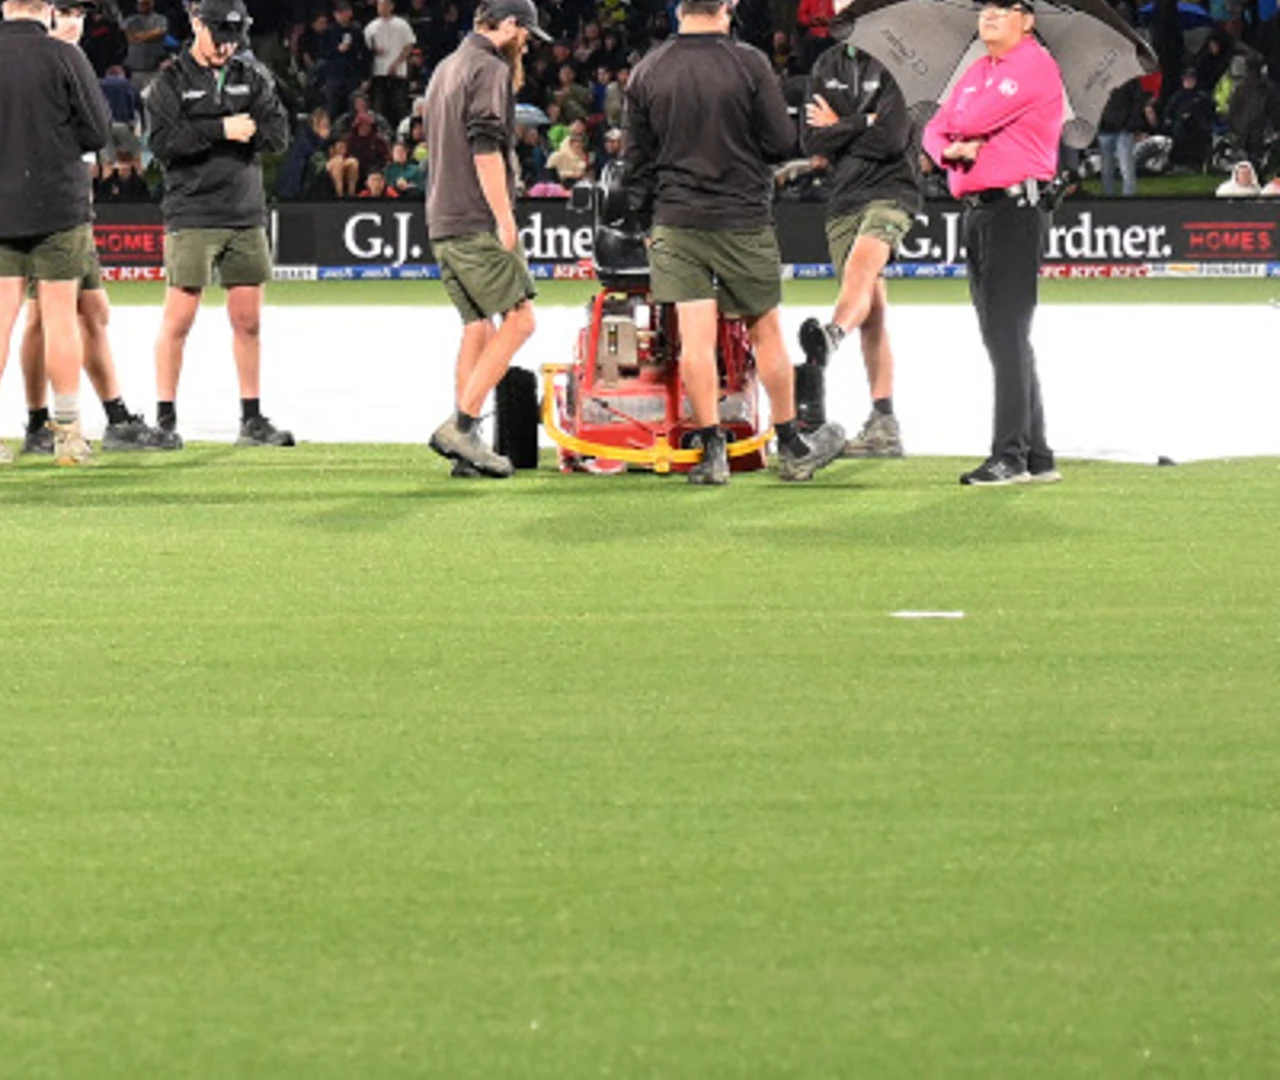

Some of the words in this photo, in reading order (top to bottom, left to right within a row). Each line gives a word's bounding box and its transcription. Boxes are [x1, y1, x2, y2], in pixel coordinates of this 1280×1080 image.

[343, 214, 422, 267] G.J.
[1043, 211, 1173, 258] rdner.
[1189, 231, 1271, 251] HOMES
[120, 267, 160, 280] KFC
[1040, 265, 1067, 278] FC
[1070, 265, 1108, 278] KFC
